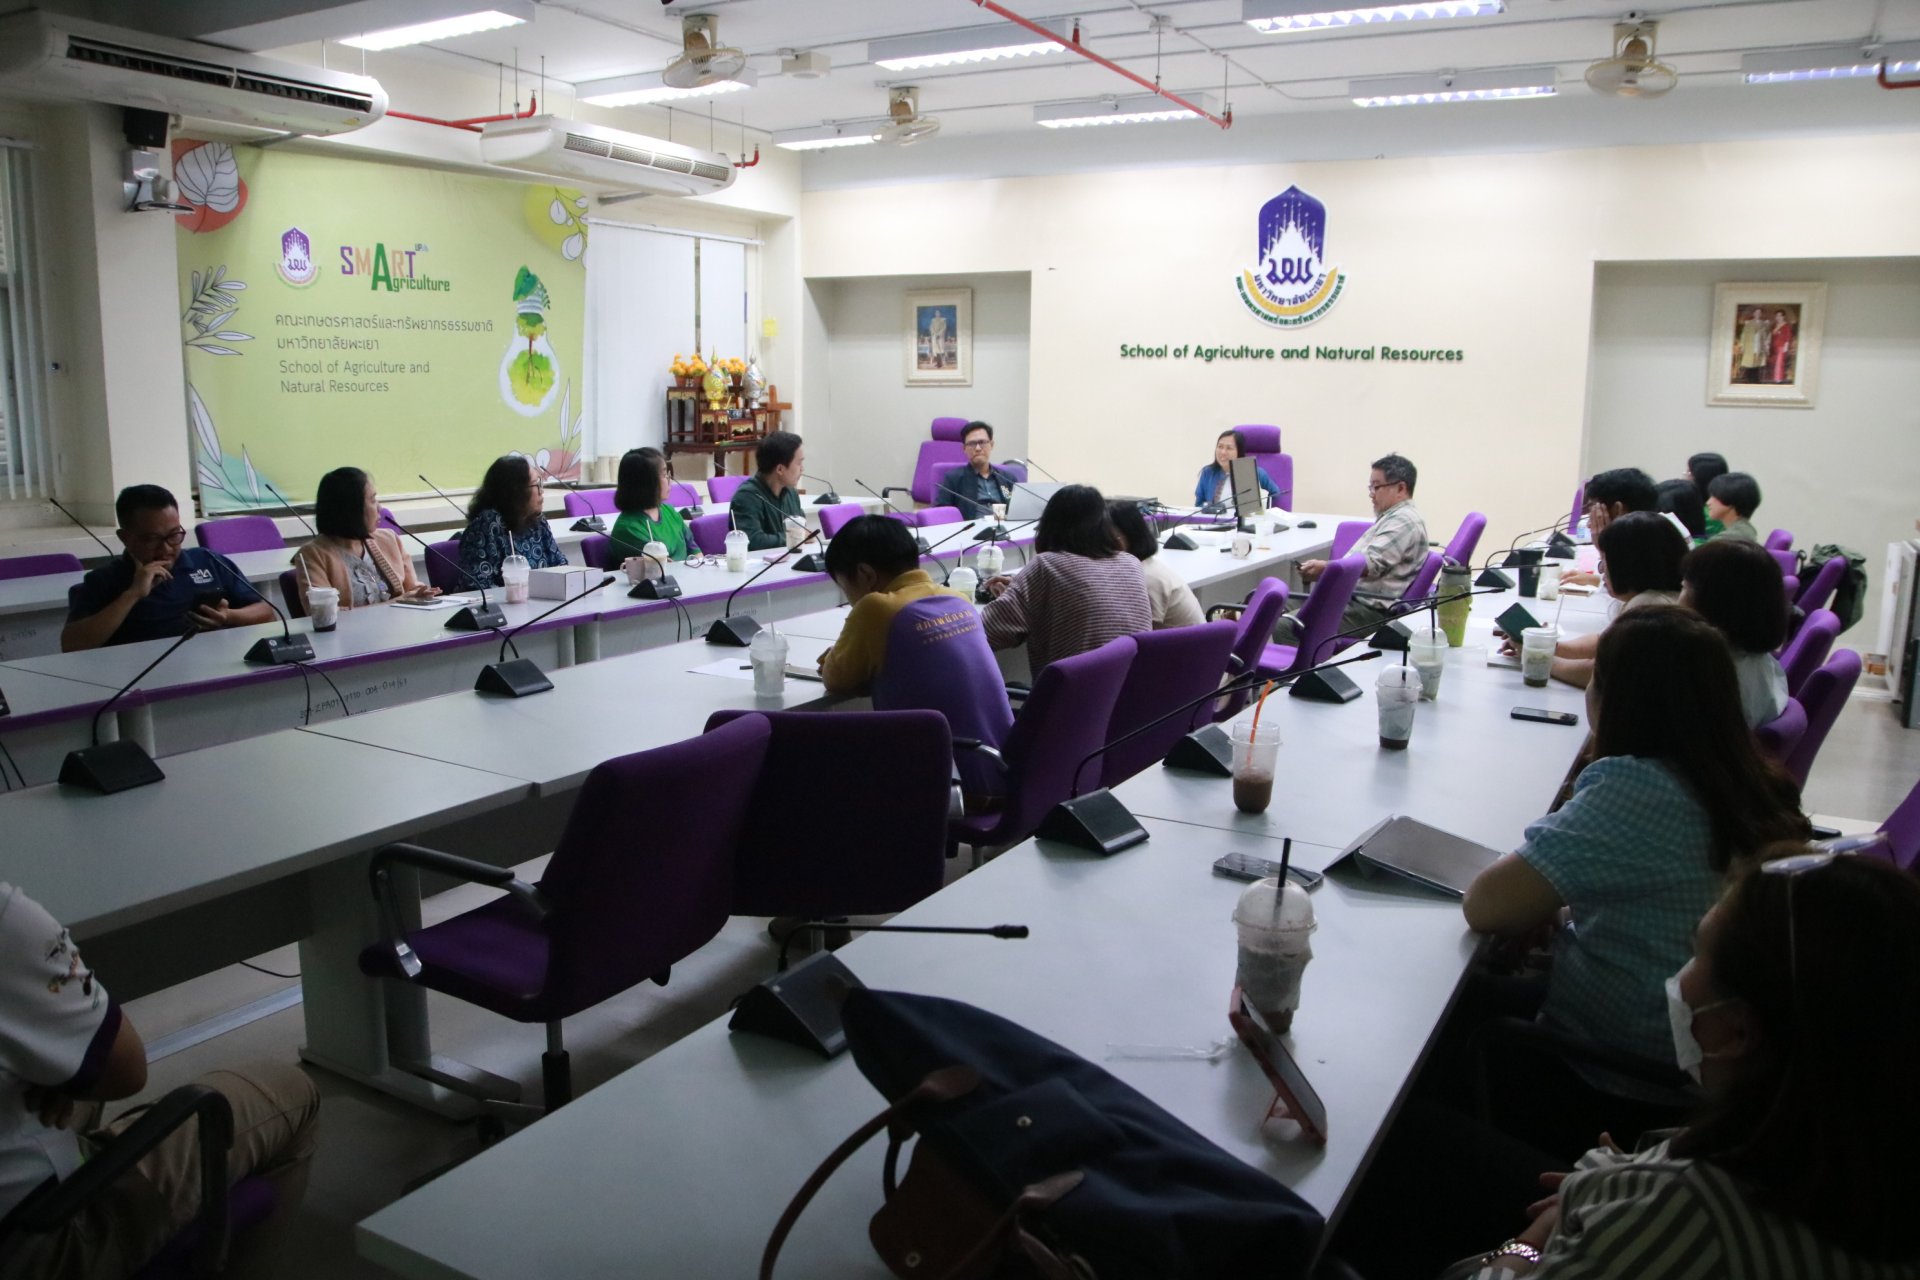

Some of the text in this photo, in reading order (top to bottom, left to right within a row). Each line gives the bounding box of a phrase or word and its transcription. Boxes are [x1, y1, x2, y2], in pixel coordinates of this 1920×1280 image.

[340, 243, 416, 289] SMART
[275, 314, 493, 332] คณะเกษตรศาสตร์และทรัพยากรธรรมชาติ
[277, 336, 379, 350] มหาวิทยาลัยพะเยา
[1120, 344, 1463, 362] School of Agriculture and Natural Resources
[279, 359, 430, 376] School of Agriculture and
[280, 380, 389, 393] Natural Resources
